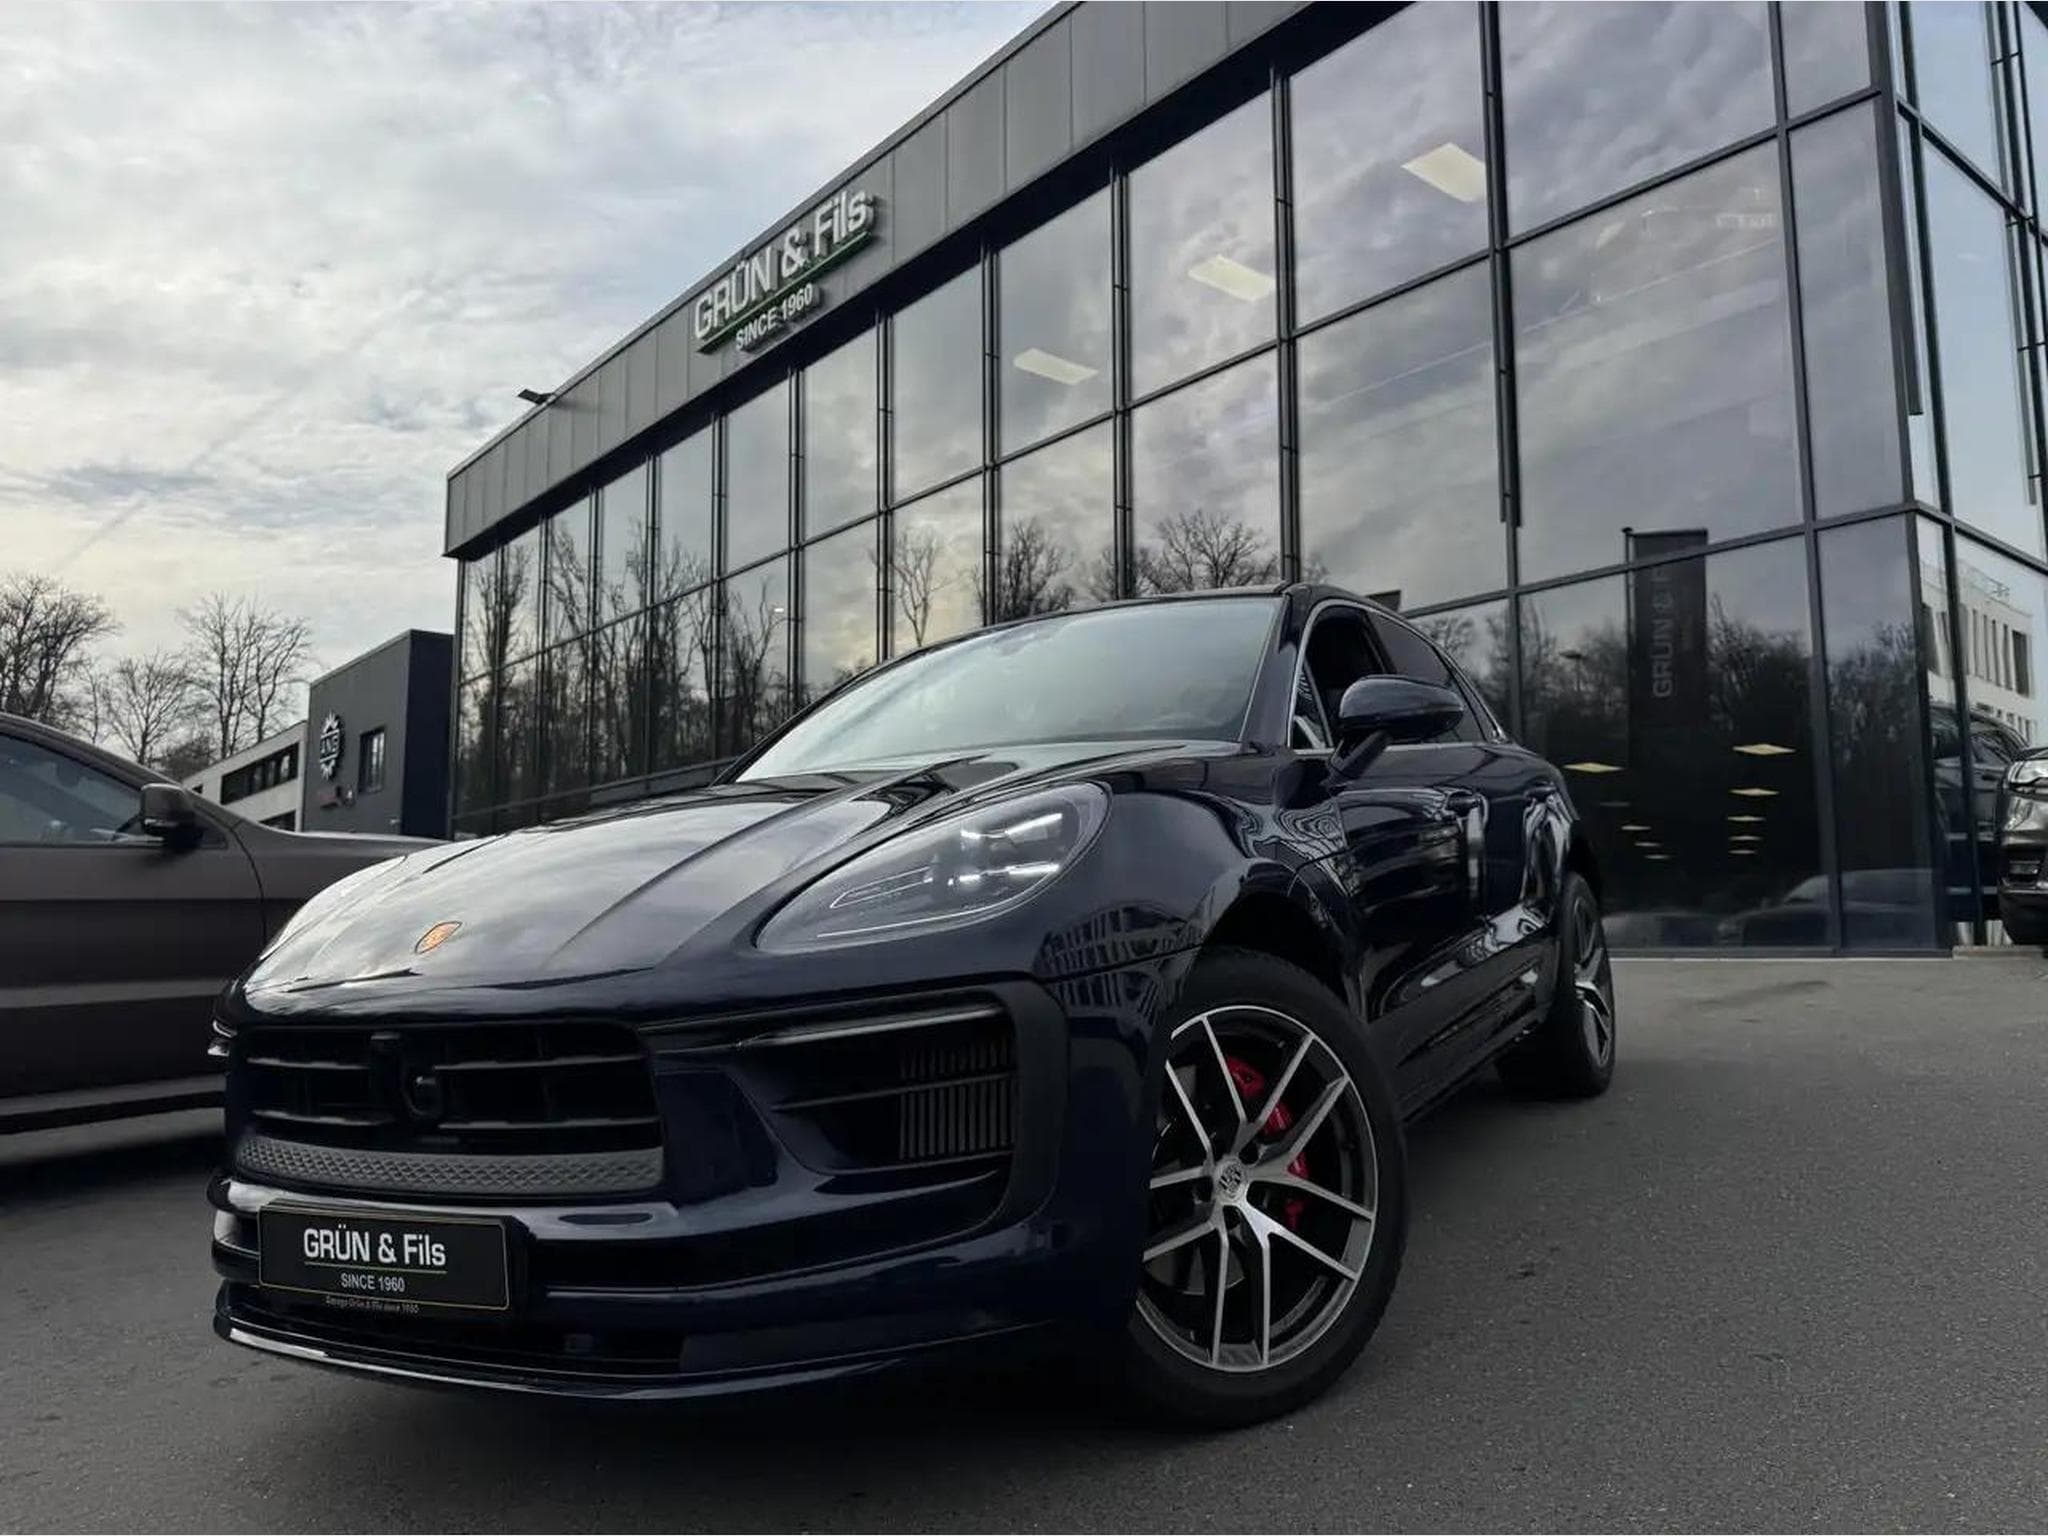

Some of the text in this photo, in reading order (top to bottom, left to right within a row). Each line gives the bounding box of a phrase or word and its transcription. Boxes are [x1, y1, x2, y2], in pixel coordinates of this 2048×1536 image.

[695, 190, 868, 339] GRÜN & Fils
[735, 282, 813, 350] SINCE 1960
[304, 1224, 446, 1266] GRÜN & Fils
[341, 1273, 405, 1292] SINCE 1960
